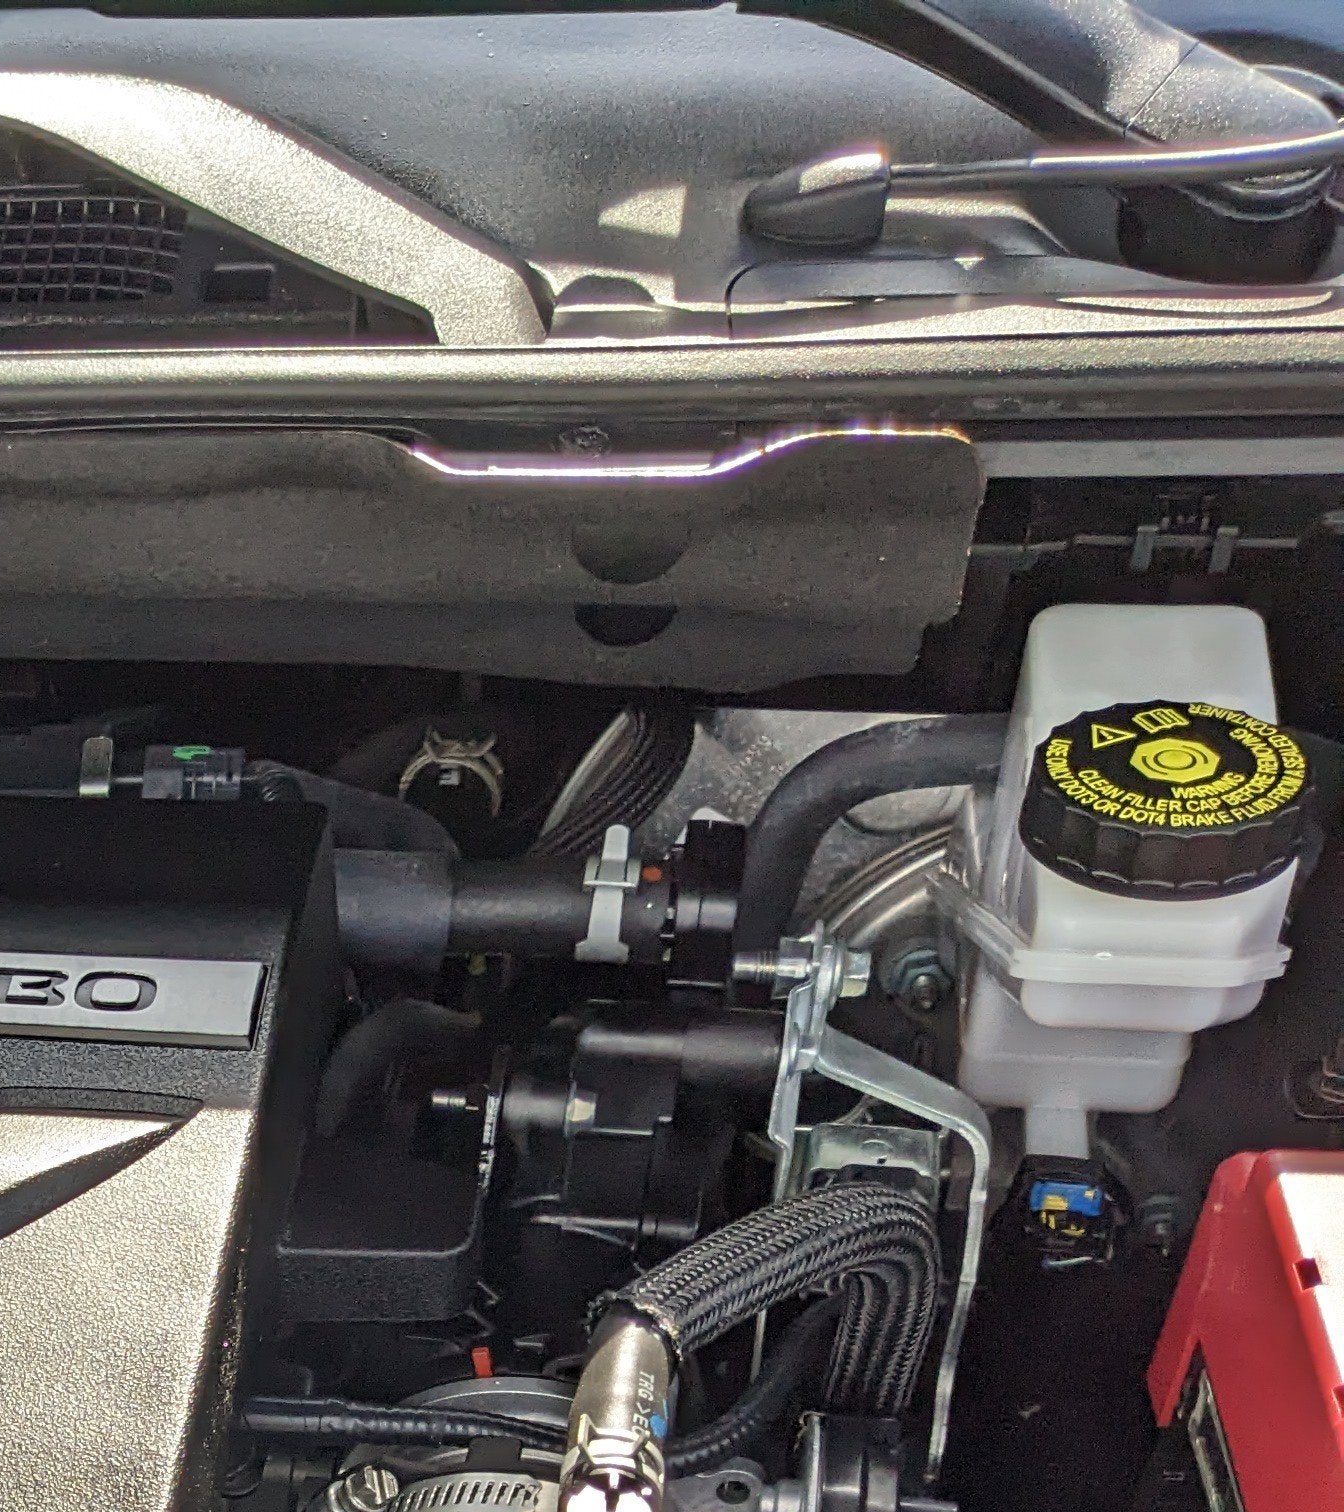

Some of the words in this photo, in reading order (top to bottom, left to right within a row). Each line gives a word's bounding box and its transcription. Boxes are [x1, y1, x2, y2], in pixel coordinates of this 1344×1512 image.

[1188, 703, 1278, 736] CONTAINER
[1045, 738, 1073, 757] USE
[1229, 727, 1279, 775] REMOVING
[1268, 734, 1305, 769] SEALED
[1045, 757, 1074, 780] ONLY
[1058, 779, 1100, 804] DOT3
[1077, 769, 1126, 799] CLEAN
[1171, 772, 1246, 799] WARNING
[1220, 772, 1276, 806] BEFORE
[1267, 776, 1304, 803] FROM
[1093, 799, 1122, 816] OR
[1119, 791, 1182, 812] FILLER
[1185, 797, 1222, 813] CAP
[1229, 797, 1278, 820] FLUID
[1118, 806, 1166, 826] DOT4
[1170, 811, 1234, 827] BRAKE
